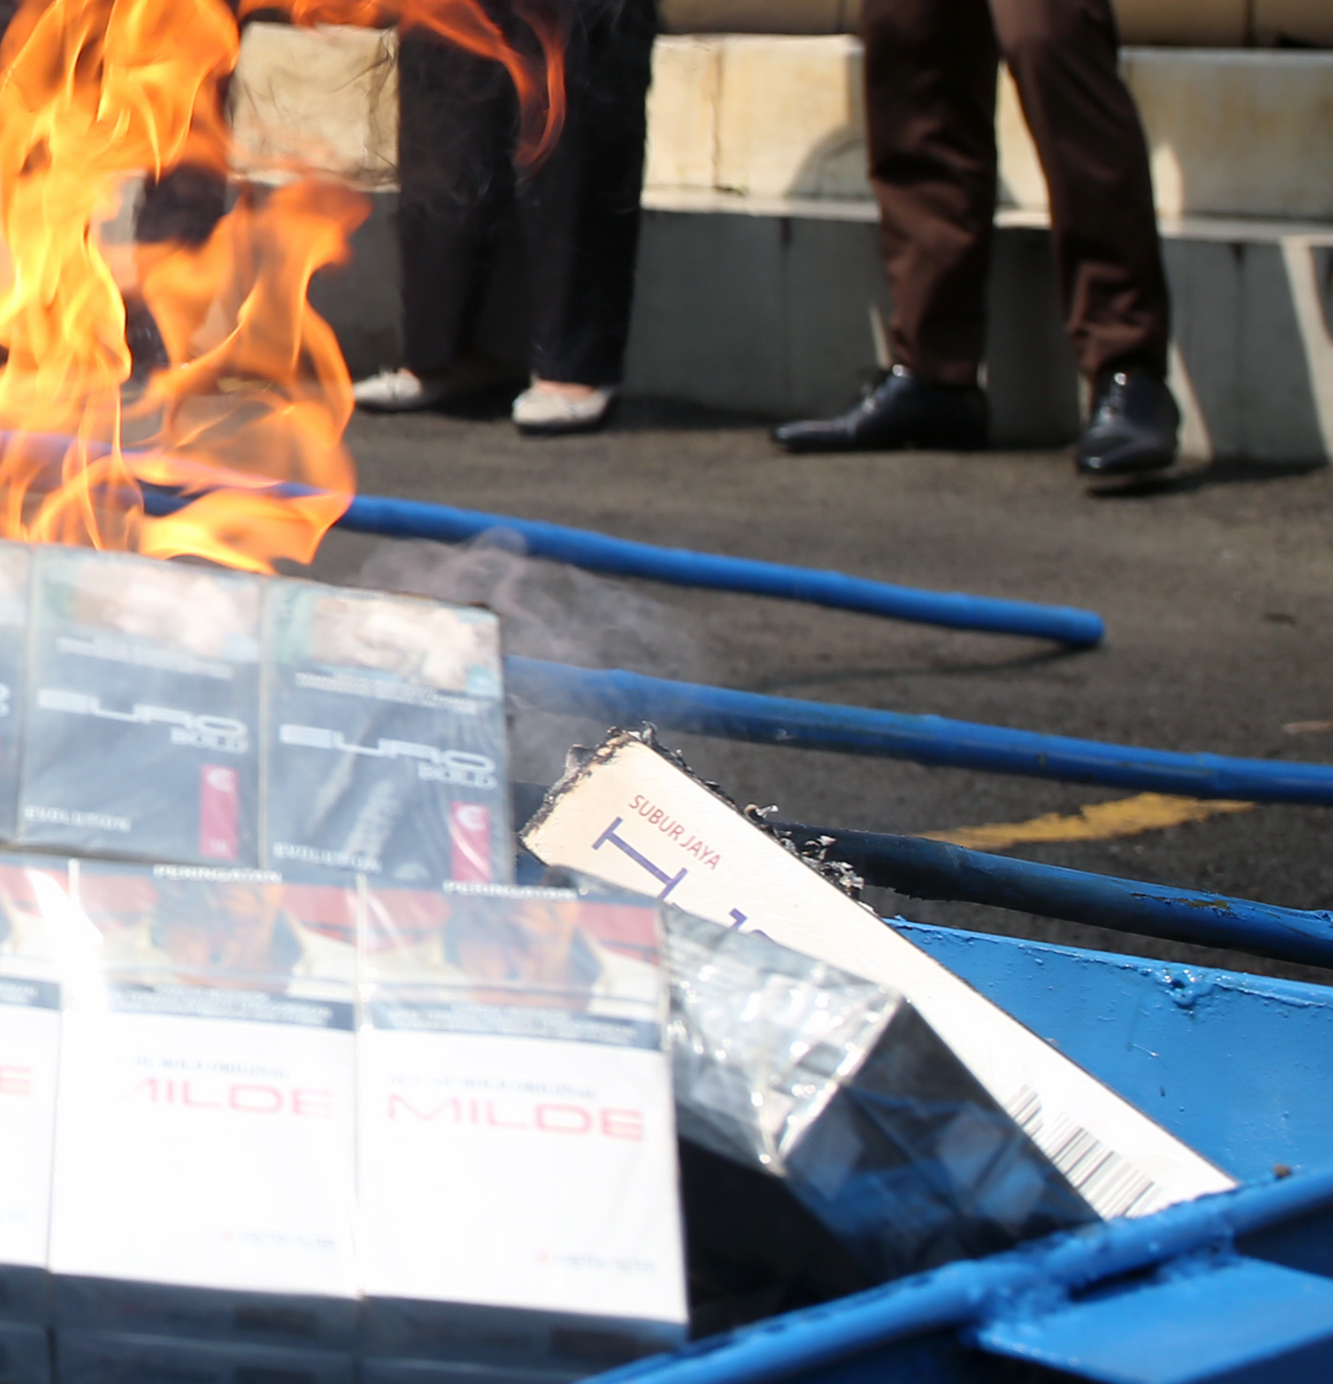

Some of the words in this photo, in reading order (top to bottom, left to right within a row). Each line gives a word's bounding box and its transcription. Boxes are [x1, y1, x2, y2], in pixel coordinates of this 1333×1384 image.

[37, 688, 248, 738] EURO
[170, 726, 249, 755] BOLD
[279, 723, 497, 774] EURO
[417, 761, 498, 791] BOLD
[629, 794, 685, 843] SUBUR
[679, 835, 722, 871] JAYA
[387, 1092, 645, 1143] MILDE
